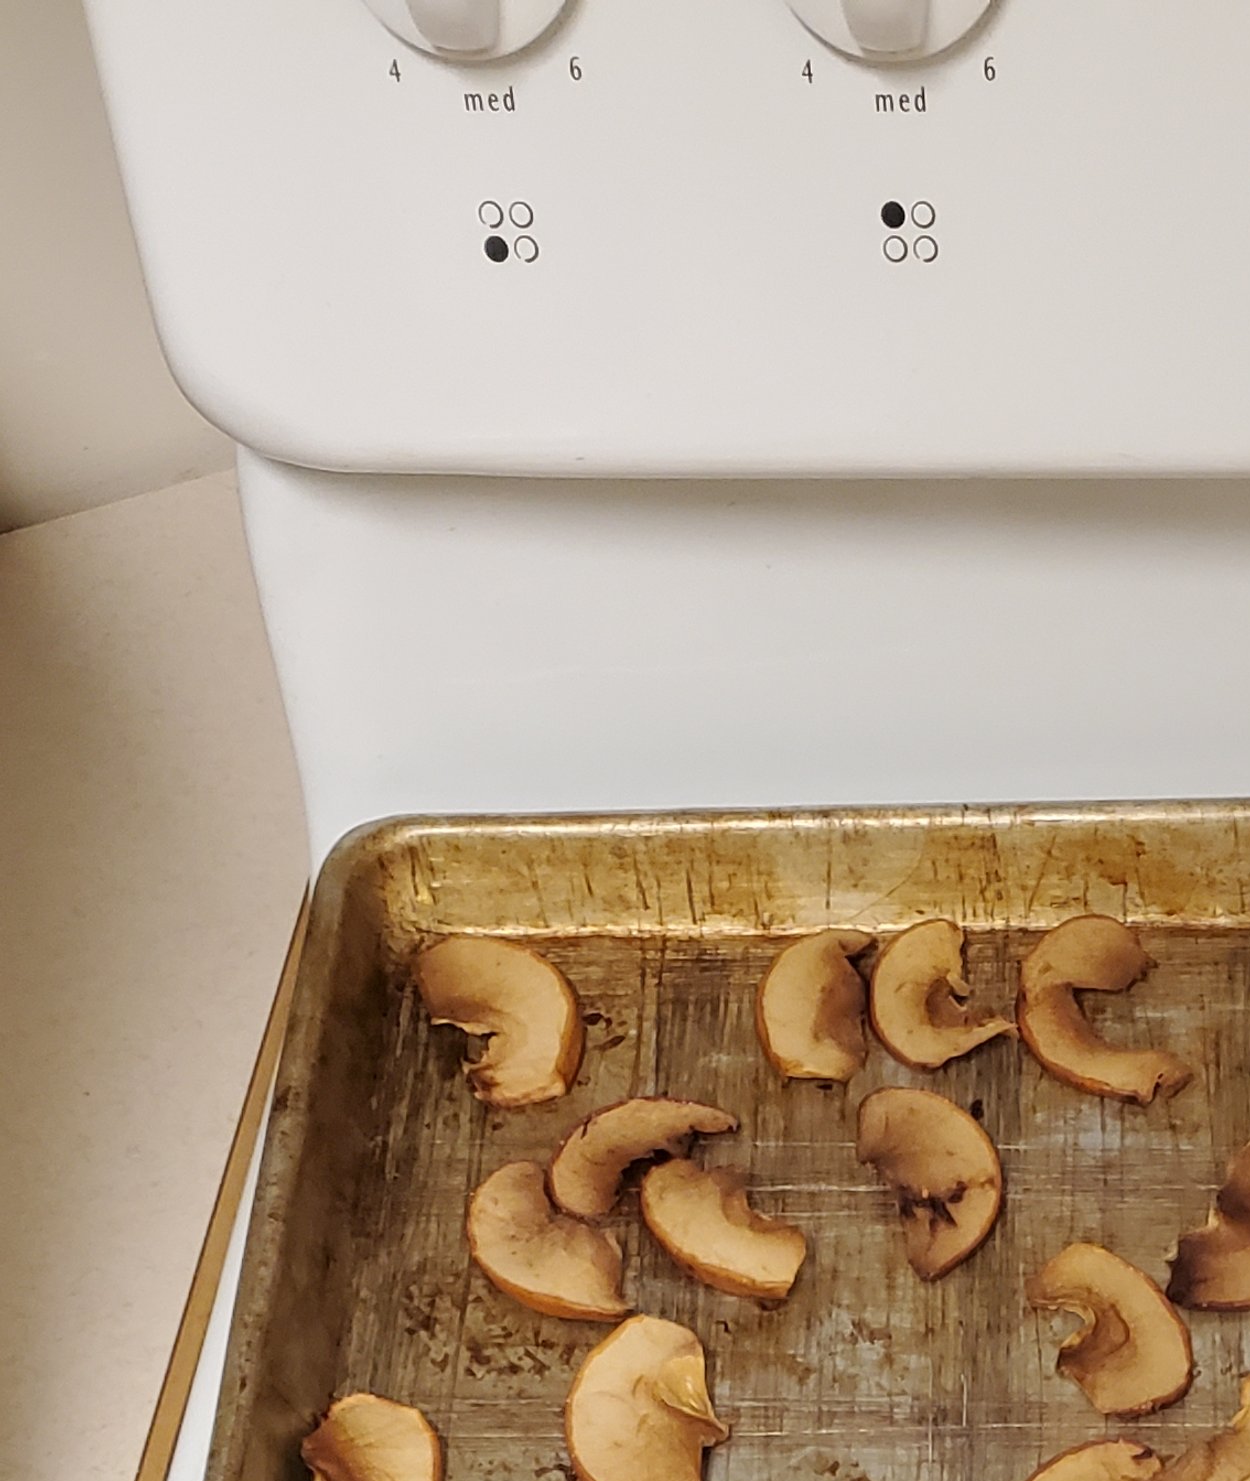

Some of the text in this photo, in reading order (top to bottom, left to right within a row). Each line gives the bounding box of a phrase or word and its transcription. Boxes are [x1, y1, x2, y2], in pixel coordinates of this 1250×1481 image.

[388, 58, 402, 83] 4
[569, 56, 583, 82] 6
[801, 59, 814, 84] 4
[983, 56, 996, 82] 6
[463, 86, 516, 112] med
[875, 86, 928, 113] med
